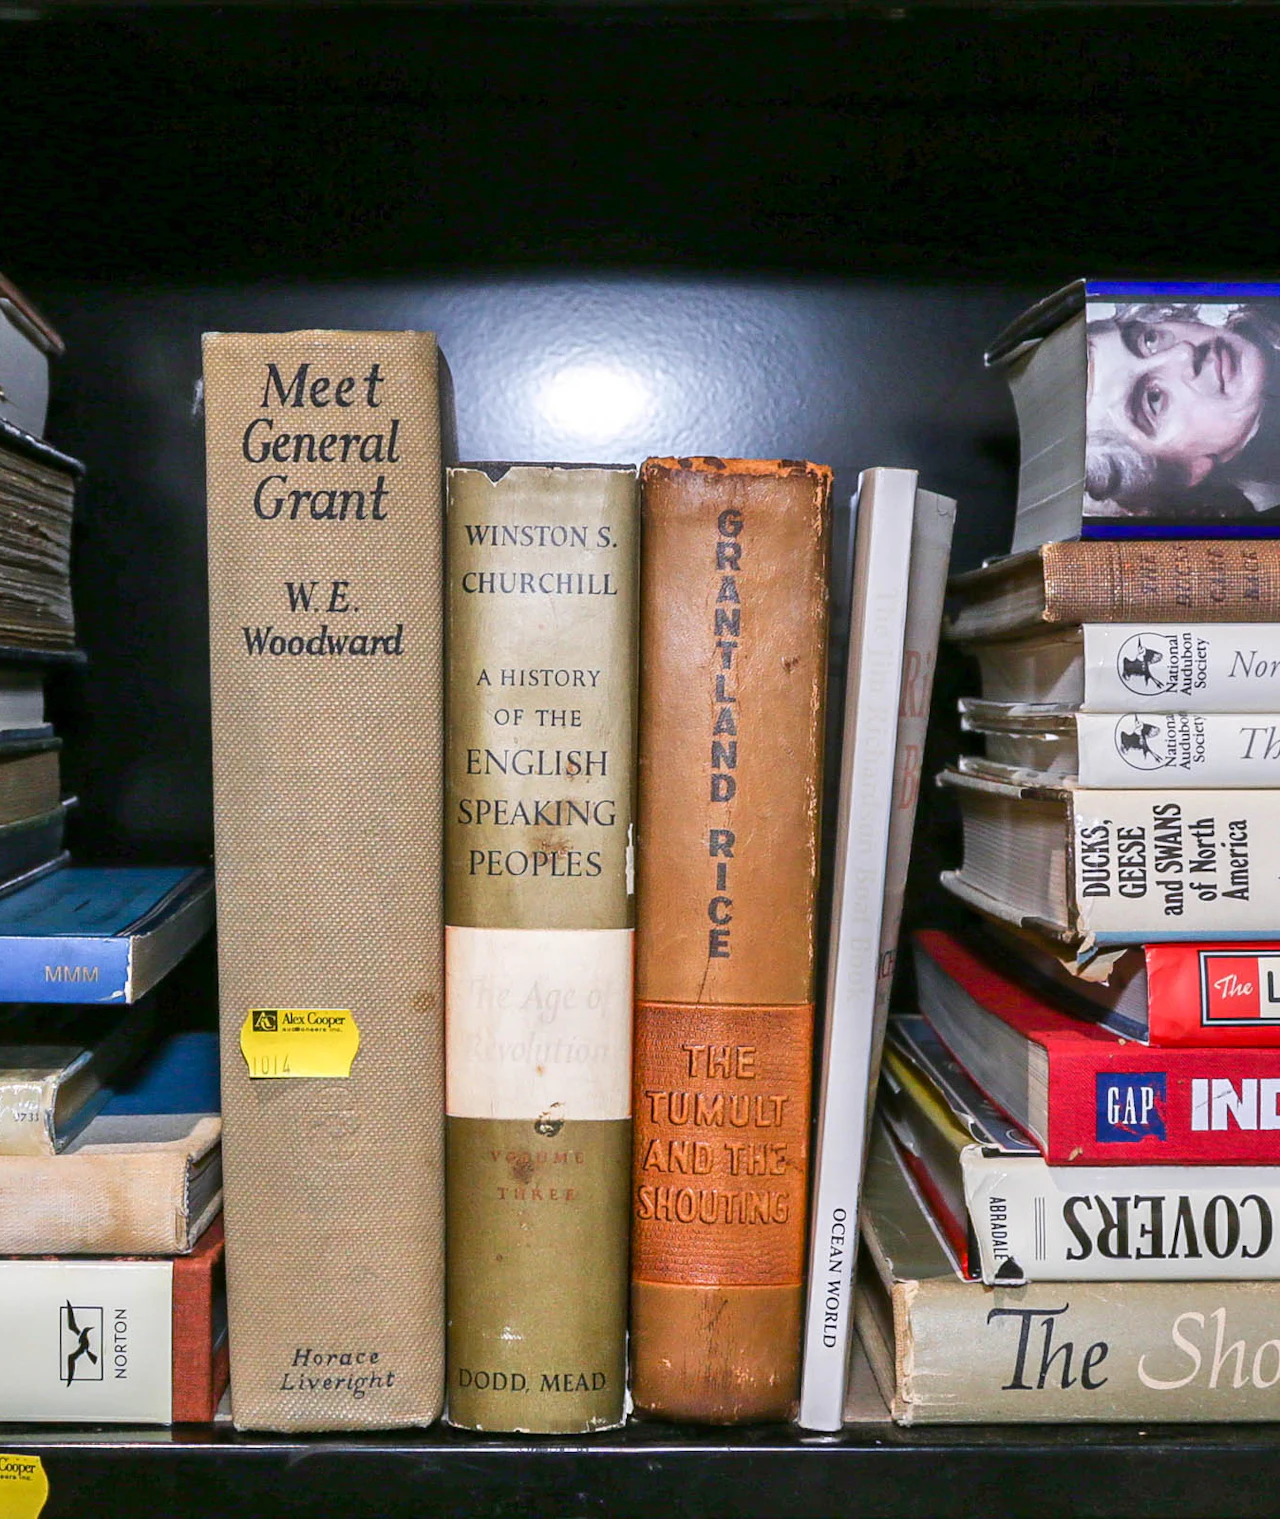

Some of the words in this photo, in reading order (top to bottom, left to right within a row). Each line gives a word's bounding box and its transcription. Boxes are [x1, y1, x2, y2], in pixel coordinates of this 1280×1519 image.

[261, 363, 385, 408] Meet
[242, 418, 401, 464] General
[253, 475, 390, 521] Grant
[464, 525, 588, 548] WINSTON
[596, 526, 618, 548] S.
[284, 581, 321, 613] W.
[326, 581, 360, 613] E.
[462, 572, 618, 596] CHURCHILL
[242, 624, 405, 657] Woodward
[709, 508, 744, 805] GRANTLAND
[476, 668, 492, 688] A
[500, 669, 602, 688] HISTORY
[1166, 634, 1179, 694] National
[1180, 632, 1193, 696] Audubon
[1194, 637, 1210, 689] Society
[494, 708, 524, 728] OF
[535, 709, 583, 728] THE
[466, 749, 608, 777] ENGLISH
[457, 799, 617, 828] SPEAKING
[1081, 818, 1113, 898] DUCKS,
[1153, 803, 1183, 874] SWANS
[1189, 816, 1217, 874] North
[468, 849, 603, 878] PEOPLES
[1118, 825, 1147, 899] GEESE
[1222, 818, 1250, 902] America
[707, 827, 737, 960] RICE
[1164, 880, 1184, 916] and
[1189, 881, 1218, 902] of
[44, 964, 100, 984] MMM
[1213, 973, 1254, 999] The
[281, 1012, 305, 1025] Alex
[307, 1012, 346, 1028] Cooper
[253, 1054, 291, 1076] 1014
[682, 1043, 757, 1079] THE
[645, 1089, 790, 1128] TUMULT
[1107, 1085, 1155, 1126] GAP
[642, 1138, 716, 1176] AND
[724, 1141, 790, 1177] THE
[497, 1186, 577, 1202] THREE
[636, 1183, 791, 1226] SHOUTING
[828, 1207, 848, 1274] OCEAN
[989, 1196, 1009, 1261] ABRADALE
[1062, 1193, 1274, 1261] COVERS
[822, 1280, 842, 1349] WORLD
[115, 1308, 128, 1380] NORTON
[292, 1348, 380, 1367] Horace
[986, 1303, 1110, 1391] The
[280, 1370, 396, 1400] Liveright
[458, 1369, 531, 1395] DODD,
[539, 1369, 607, 1394] MEAD
